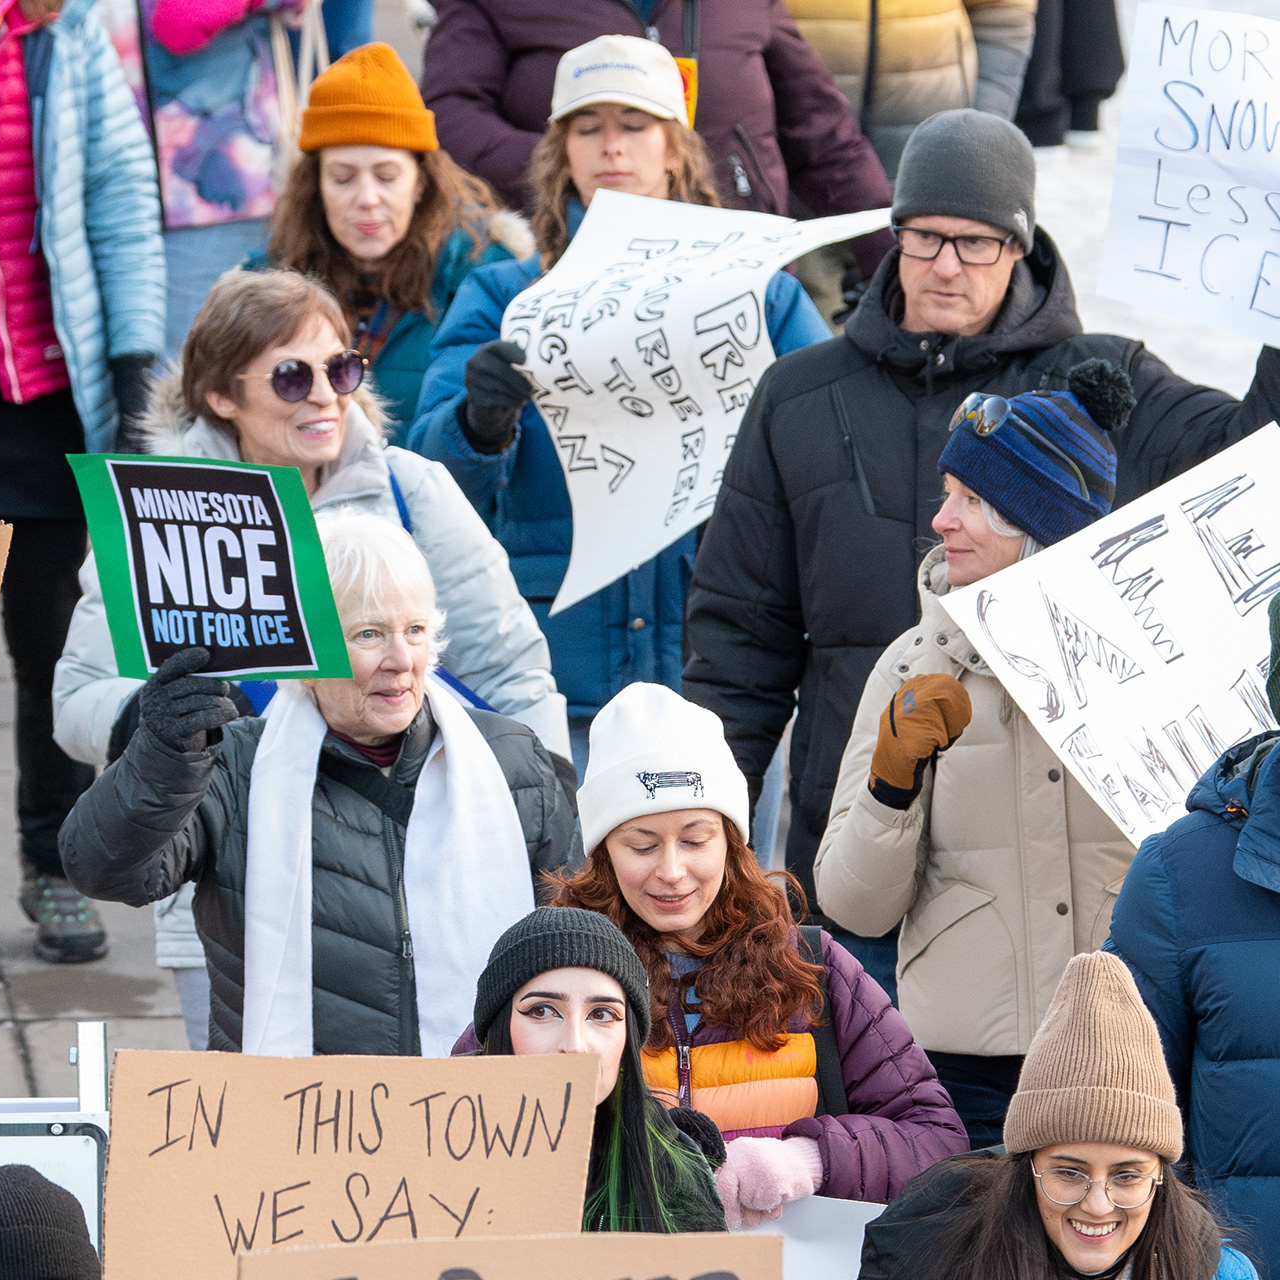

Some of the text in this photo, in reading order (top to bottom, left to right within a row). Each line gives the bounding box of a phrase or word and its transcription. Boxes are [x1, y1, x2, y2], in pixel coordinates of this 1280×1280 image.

[602, 356, 655, 418] TO
[599, 443, 636, 495] A
[130, 487, 273, 527] MINNESOTA
[138, 521, 287, 611] NICE
[150, 608, 295, 648] NOT FOR ICE
[147, 1077, 572, 1162] IN THIS TOWN
[214, 1171, 495, 1257] WE SAY:
